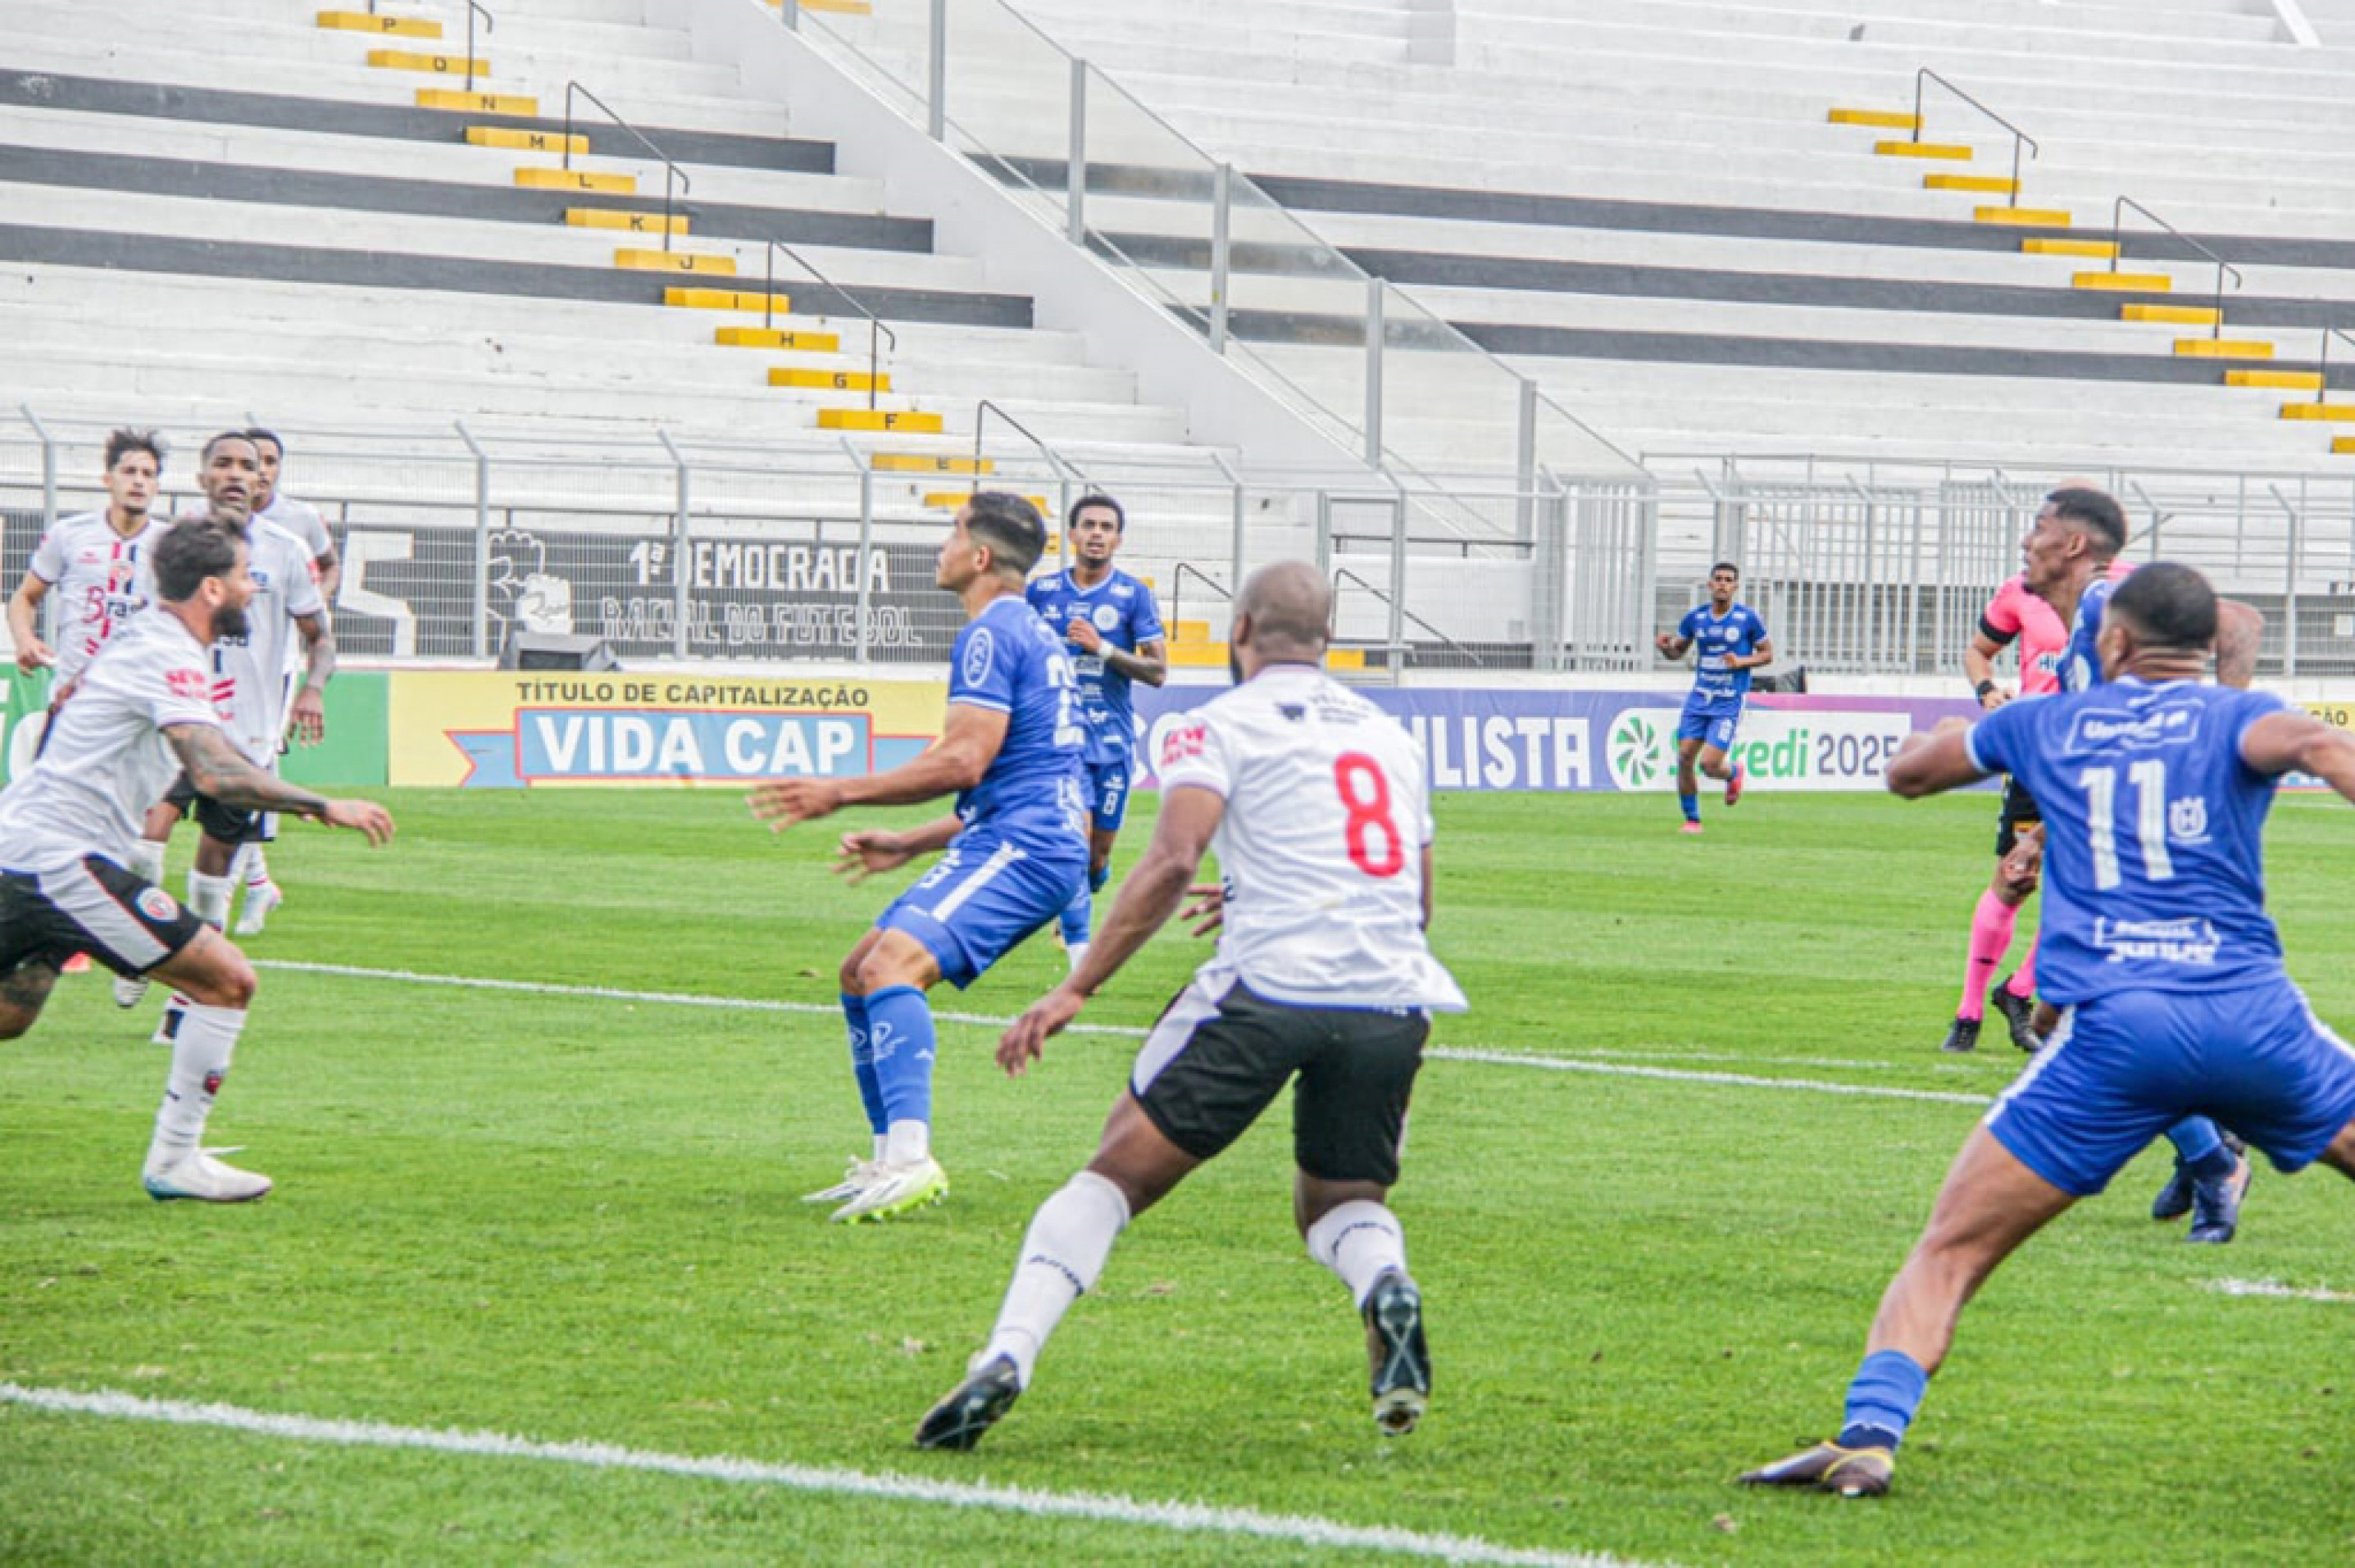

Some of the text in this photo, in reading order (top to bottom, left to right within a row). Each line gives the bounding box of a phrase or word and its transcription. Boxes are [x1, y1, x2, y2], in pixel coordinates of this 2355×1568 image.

[382, 18, 397, 31] P
[480, 96, 496, 111] N
[530, 134, 545, 148] M
[579, 174, 593, 189] L
[630, 216, 644, 230] K
[680, 255, 694, 269] J
[780, 332, 794, 347] H
[833, 372, 848, 389] G
[884, 412, 898, 429] F
[936, 457, 950, 470] E
[516, 678, 869, 710] TÍTULO DE CAPITALIZAÇÃO
[535, 716, 854, 775] VIDA CAP
[1332, 751, 1405, 879] 8
[2079, 758, 2175, 890] 11
